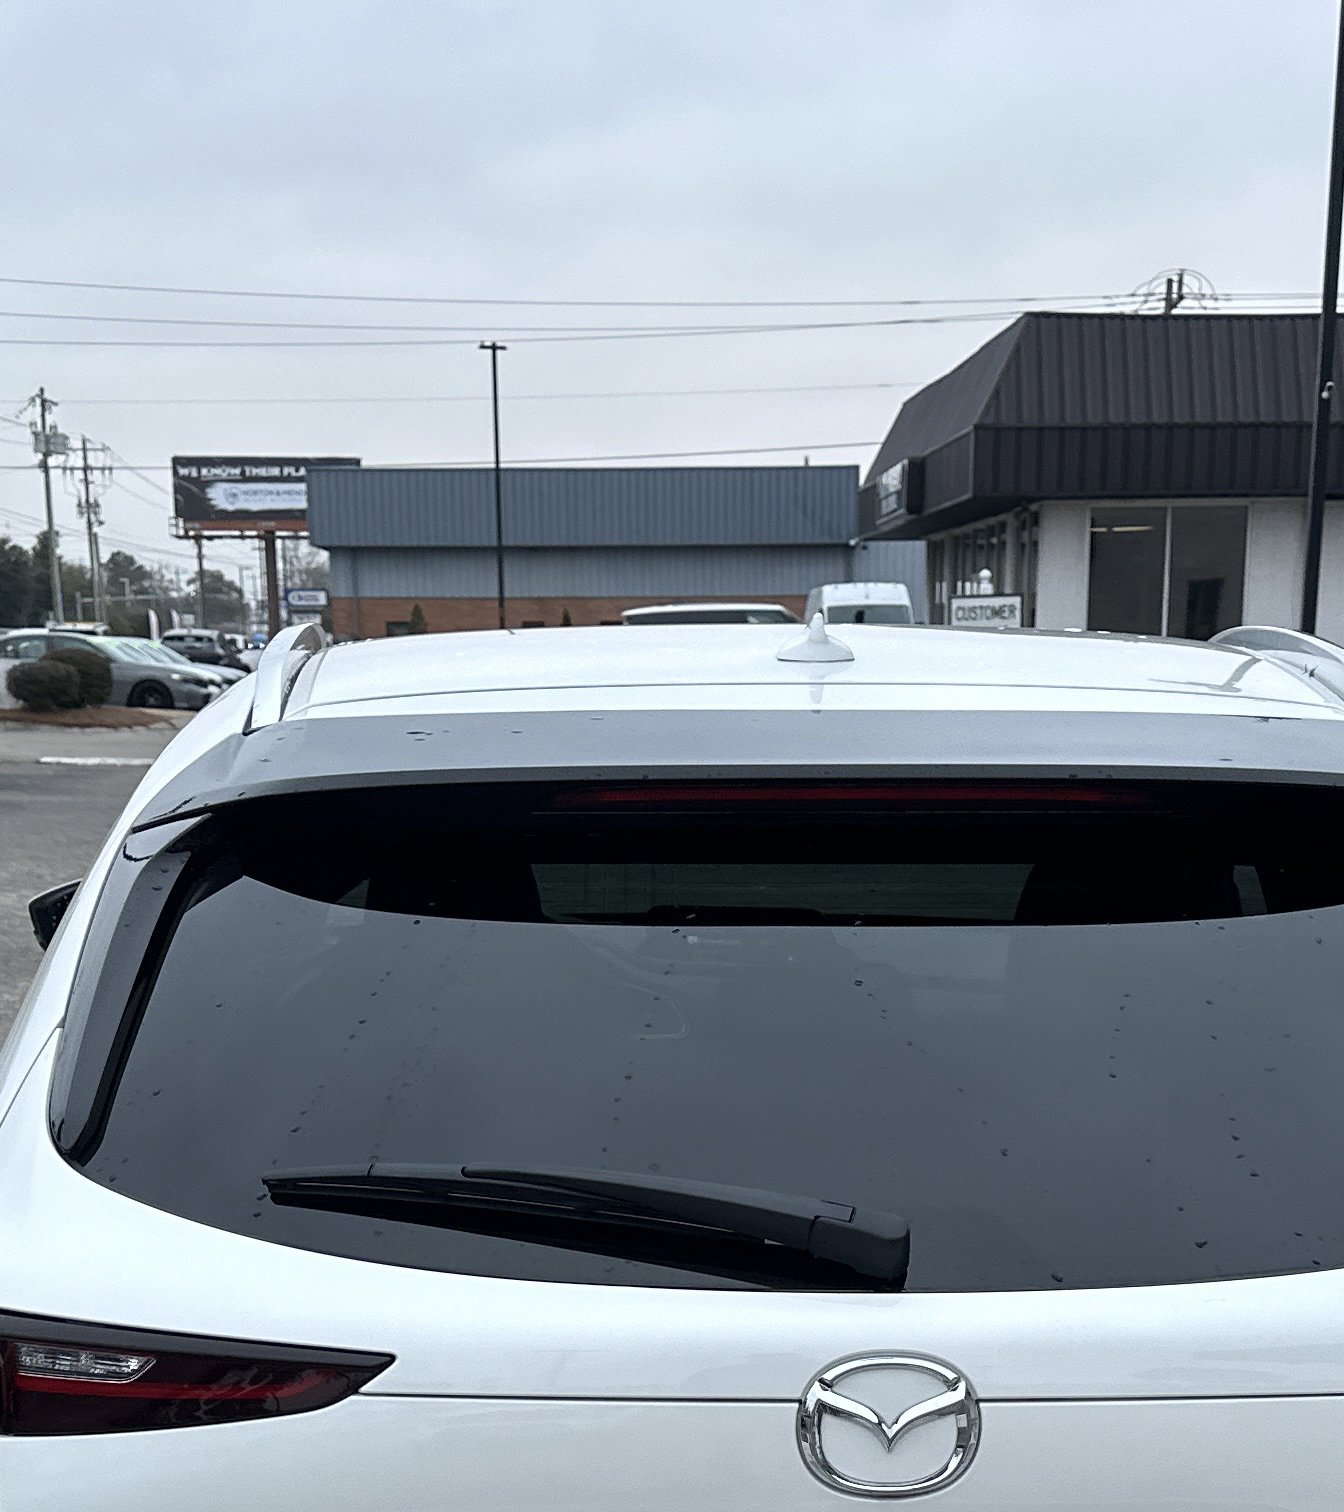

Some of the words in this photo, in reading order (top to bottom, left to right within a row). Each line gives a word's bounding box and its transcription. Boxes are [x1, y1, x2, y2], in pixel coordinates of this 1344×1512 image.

[176, 465, 199, 478] WE
[201, 465, 242, 477] KNOW
[244, 465, 281, 477] THEIR
[283, 465, 306, 477] PLA
[955, 604, 1017, 621] CUSTOMER
